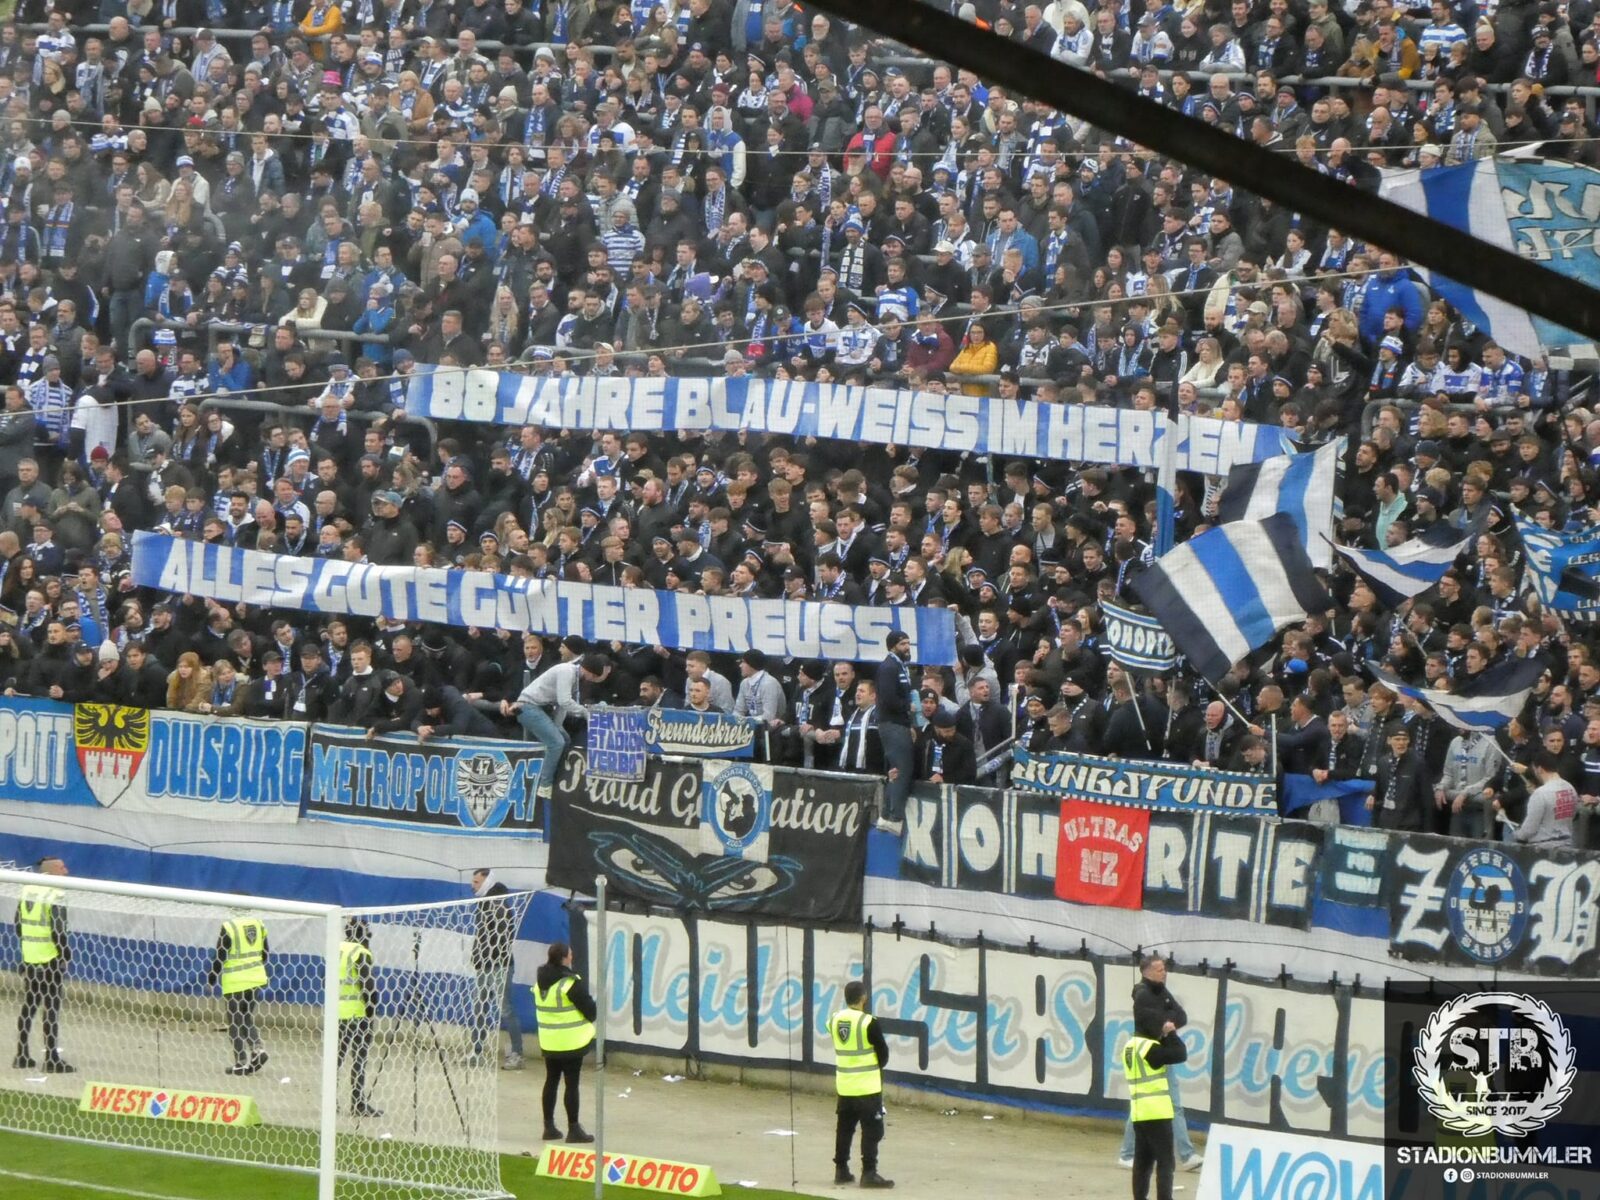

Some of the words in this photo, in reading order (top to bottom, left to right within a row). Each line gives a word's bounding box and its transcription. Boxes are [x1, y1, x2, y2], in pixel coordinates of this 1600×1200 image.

[430, 369, 499, 421] 88
[503, 374, 665, 430] JAHRE
[676, 377, 979, 451] BLAU-WEISS
[987, 397, 1038, 455] IM
[1048, 404, 1258, 476] HERZEN
[158, 538, 313, 607] ALLES
[313, 558, 449, 624] GUTE
[459, 570, 660, 645] GÜNTER
[676, 592, 919, 662] PREUSS!
[645, 705, 755, 746] Freundeskreis
[146, 718, 306, 807] DUISBURG
[310, 743, 460, 815] METROPOL
[508, 757, 544, 822] 47
[475, 759, 491, 776] 47
[559, 750, 662, 816] Proud
[670, 772, 860, 838] Gation
[1064, 815, 1144, 853] ULTRAS
[903, 797, 1316, 908] KOHRTE
[1080, 848, 1119, 887] MZ
[90, 1085, 153, 1114] WEST
[167, 1094, 241, 1123] LOTTO
[547, 1149, 611, 1179] WEST
[625, 1159, 699, 1193] LOTTO
